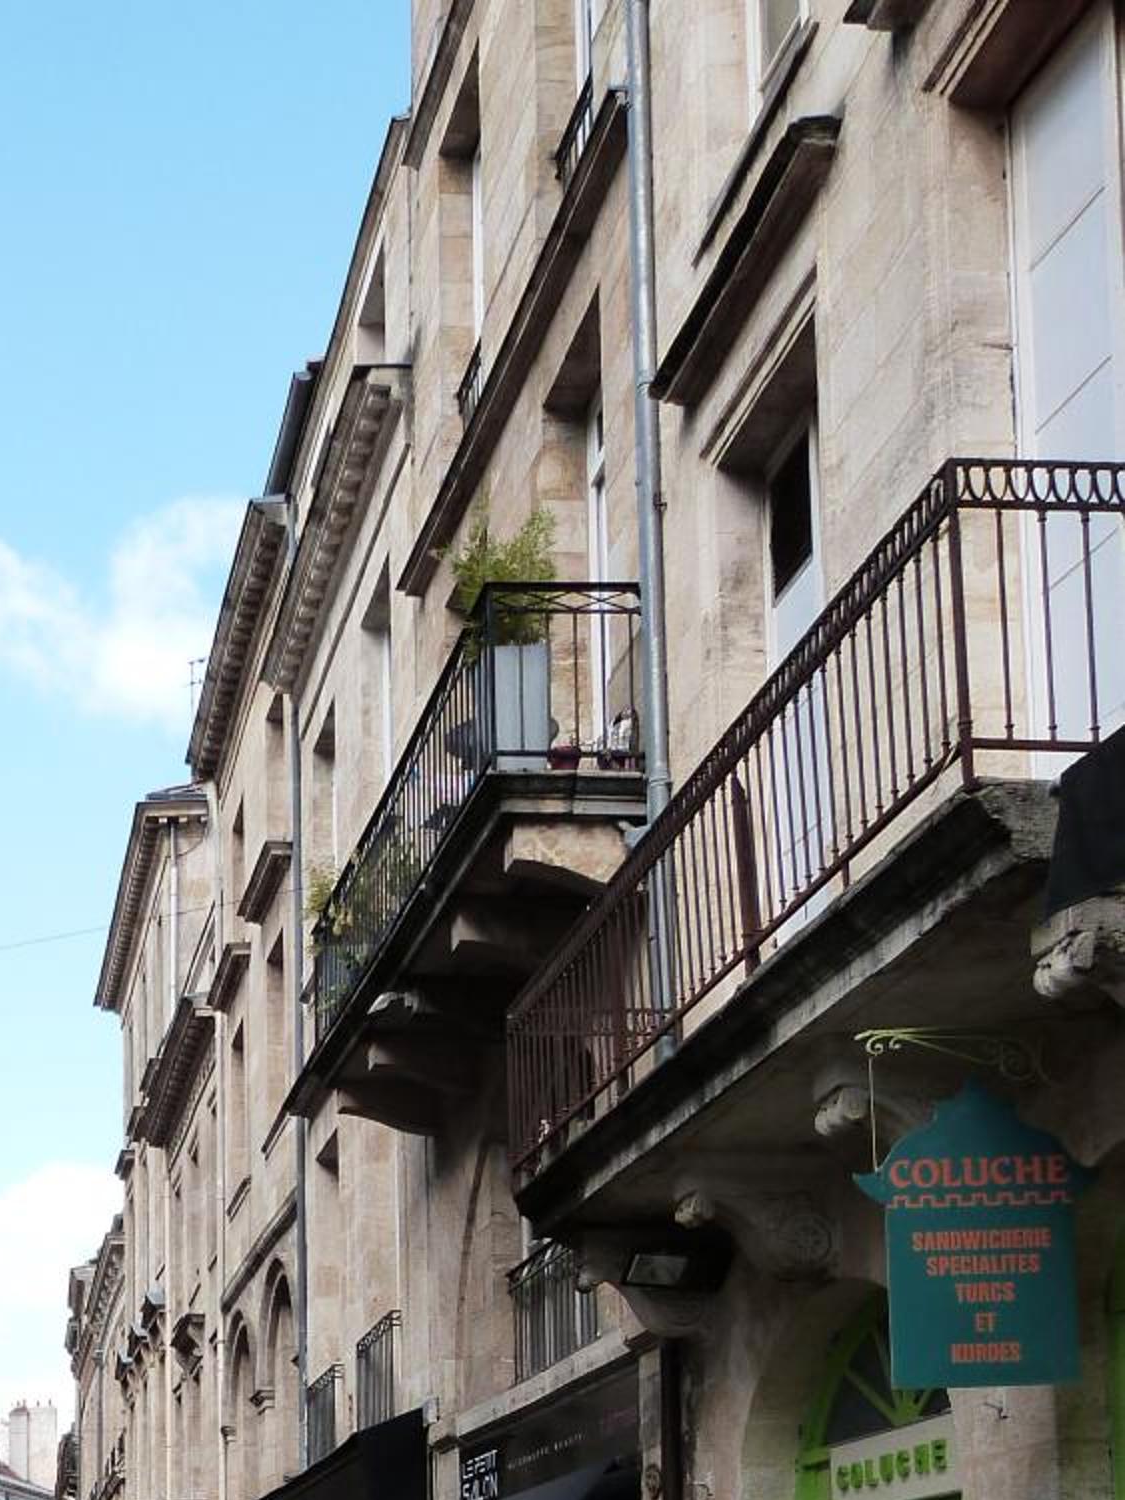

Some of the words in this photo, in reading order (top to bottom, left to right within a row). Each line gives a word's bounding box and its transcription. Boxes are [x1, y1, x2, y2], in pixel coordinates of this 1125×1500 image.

[889, 1155, 1068, 1188] COLUCHE
[912, 1226, 1052, 1252] SANDWICHERIE
[955, 1281, 1016, 1304] TURCS
[975, 1312, 996, 1333] ET
[836, 1438, 948, 1493] COLUCHE
